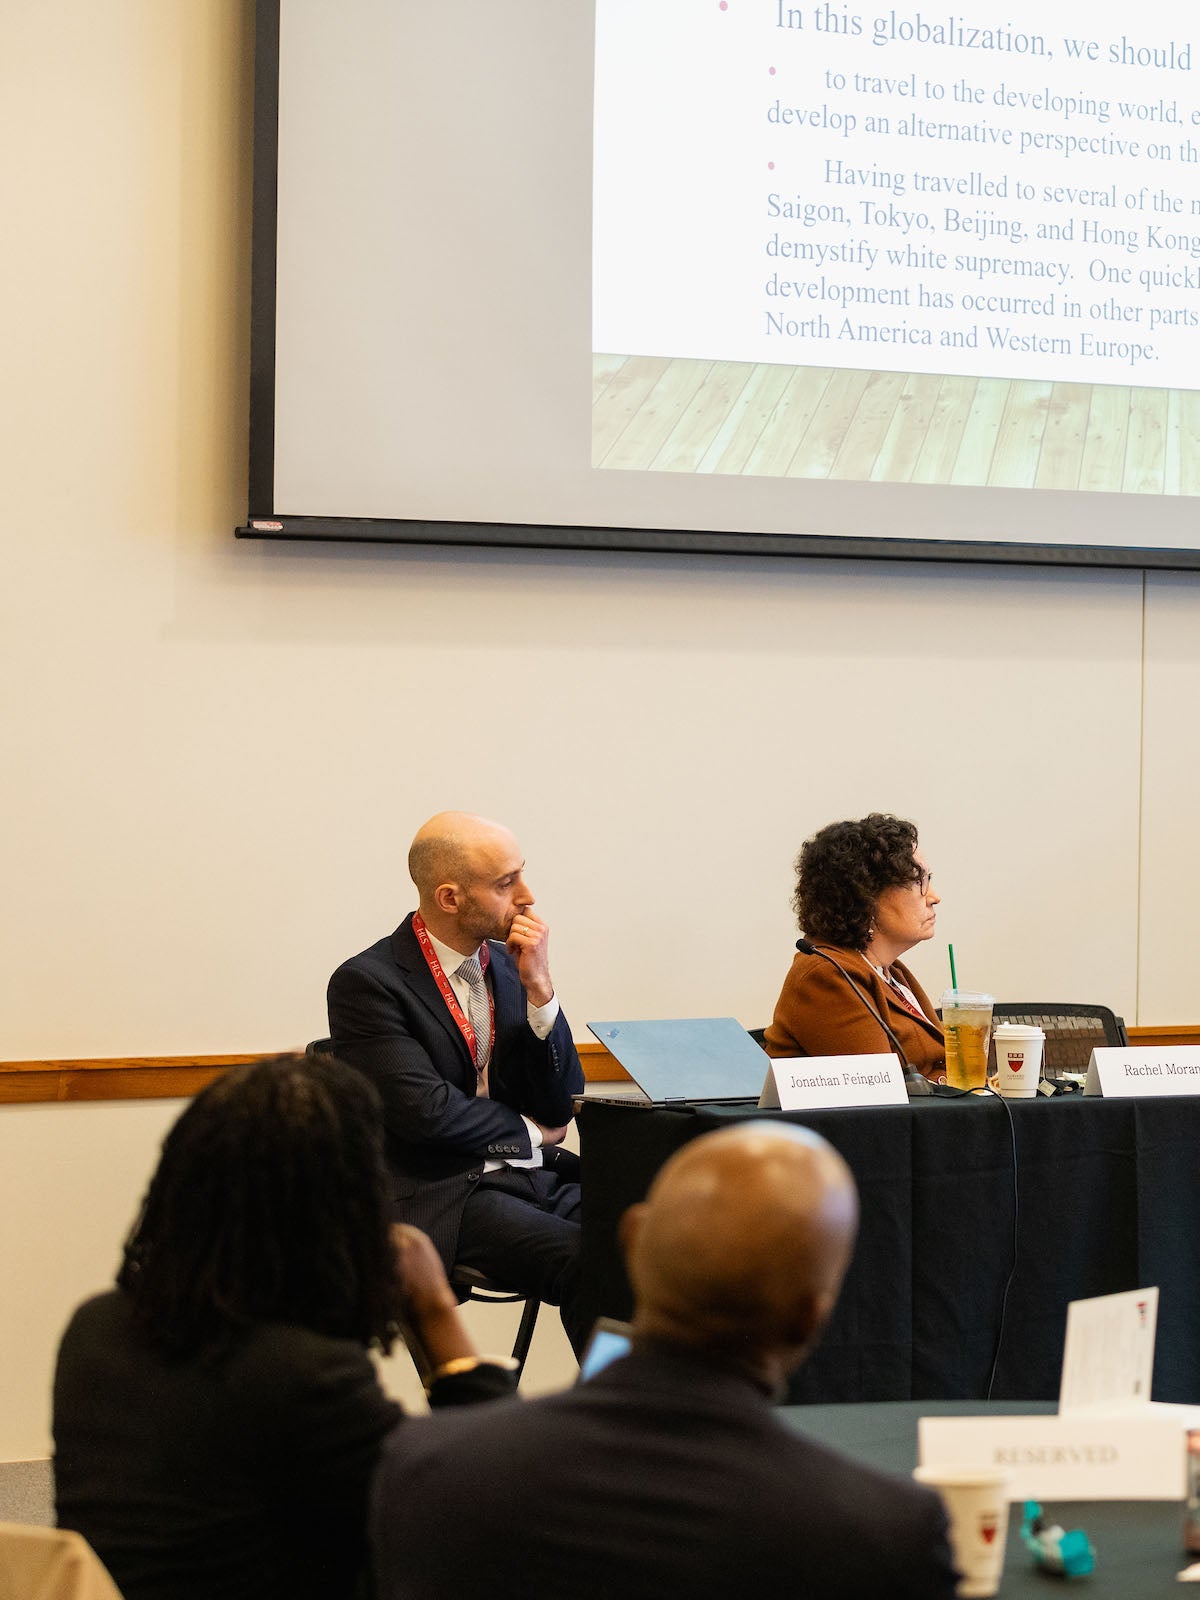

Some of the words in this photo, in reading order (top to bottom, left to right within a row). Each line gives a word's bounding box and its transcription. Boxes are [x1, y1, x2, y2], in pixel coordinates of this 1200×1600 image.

[775, 0, 804, 30] In
[813, 1, 863, 36] this
[871, 9, 1054, 63] globalization,
[1063, 38, 1100, 62] we
[1108, 35, 1192, 72] should
[824, 68, 847, 91] to
[853, 71, 917, 98] travel
[924, 79, 945, 101] to
[951, 78, 986, 105] the
[992, 82, 1111, 124] developing
[1116, 98, 1184, 129] world,
[767, 99, 857, 138] develop
[864, 116, 891, 135] an
[897, 112, 1013, 146] alternative
[1019, 131, 1141, 159] perspective
[1146, 143, 1172, 161] on
[823, 159, 907, 197] Having
[912, 170, 1009, 198] travelled
[1015, 180, 1036, 201] to
[1042, 184, 1117, 208] several
[1124, 186, 1149, 211] of
[1152, 188, 1184, 214] the
[767, 192, 852, 229] Saigon,
[858, 200, 936, 236] Tokyo,
[943, 207, 1029, 245] Beijing,
[1036, 217, 1074, 241] and
[1081, 219, 1140, 254] Hong
[765, 232, 879, 272] demystify
[885, 242, 948, 270] white
[954, 255, 1074, 286] supremacy.
[1088, 258, 1132, 284] One
[764, 271, 911, 310] development
[917, 282, 955, 310] has
[960, 292, 1055, 317] occurred
[1063, 293, 1083, 319] in
[1089, 296, 1144, 323] other
[1148, 306, 1199, 332] parts
[764, 311, 831, 339] North
[836, 316, 933, 346] America
[939, 324, 979, 349] and
[984, 326, 1072, 355] Western
[1079, 332, 1159, 367] Europe.
[416, 927, 429, 945] HLS
[429, 960, 442, 977] HLS
[444, 992, 457, 1010] HLS
[460, 1023, 475, 1040] HLS
[791, 1074, 841, 1088] Jonathan
[842, 1071, 891, 1086] Feingold
[1124, 1064, 1163, 1076] Rachel
[994, 1445, 1119, 1466] RESERVED
